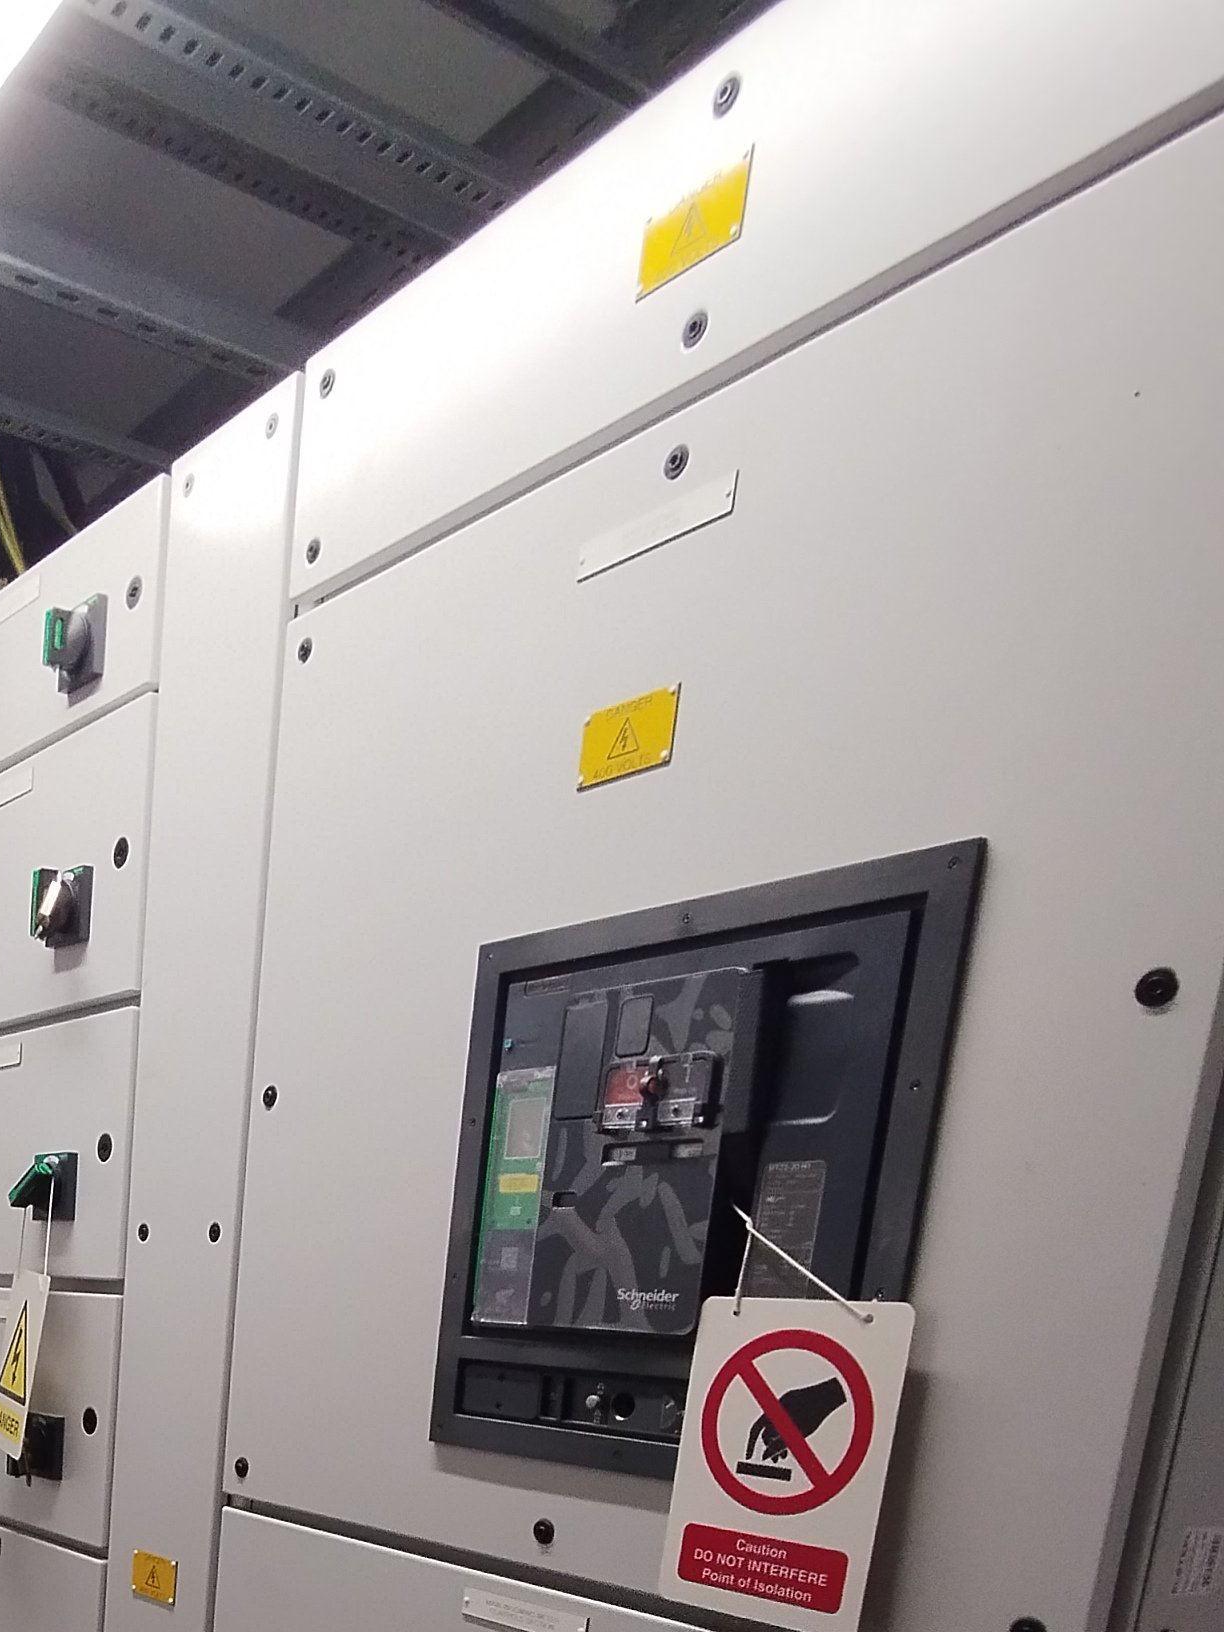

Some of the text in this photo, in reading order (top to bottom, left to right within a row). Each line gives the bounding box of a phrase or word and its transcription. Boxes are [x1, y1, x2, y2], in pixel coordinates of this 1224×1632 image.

[606, 695, 654, 718] DANGER
[617, 1288, 680, 1302] Schneider
[736, 1539, 787, 1559] Caution
[694, 1548, 829, 1587] DO NOT INTERFERE
[702, 1568, 812, 1603] Point of Isolation
